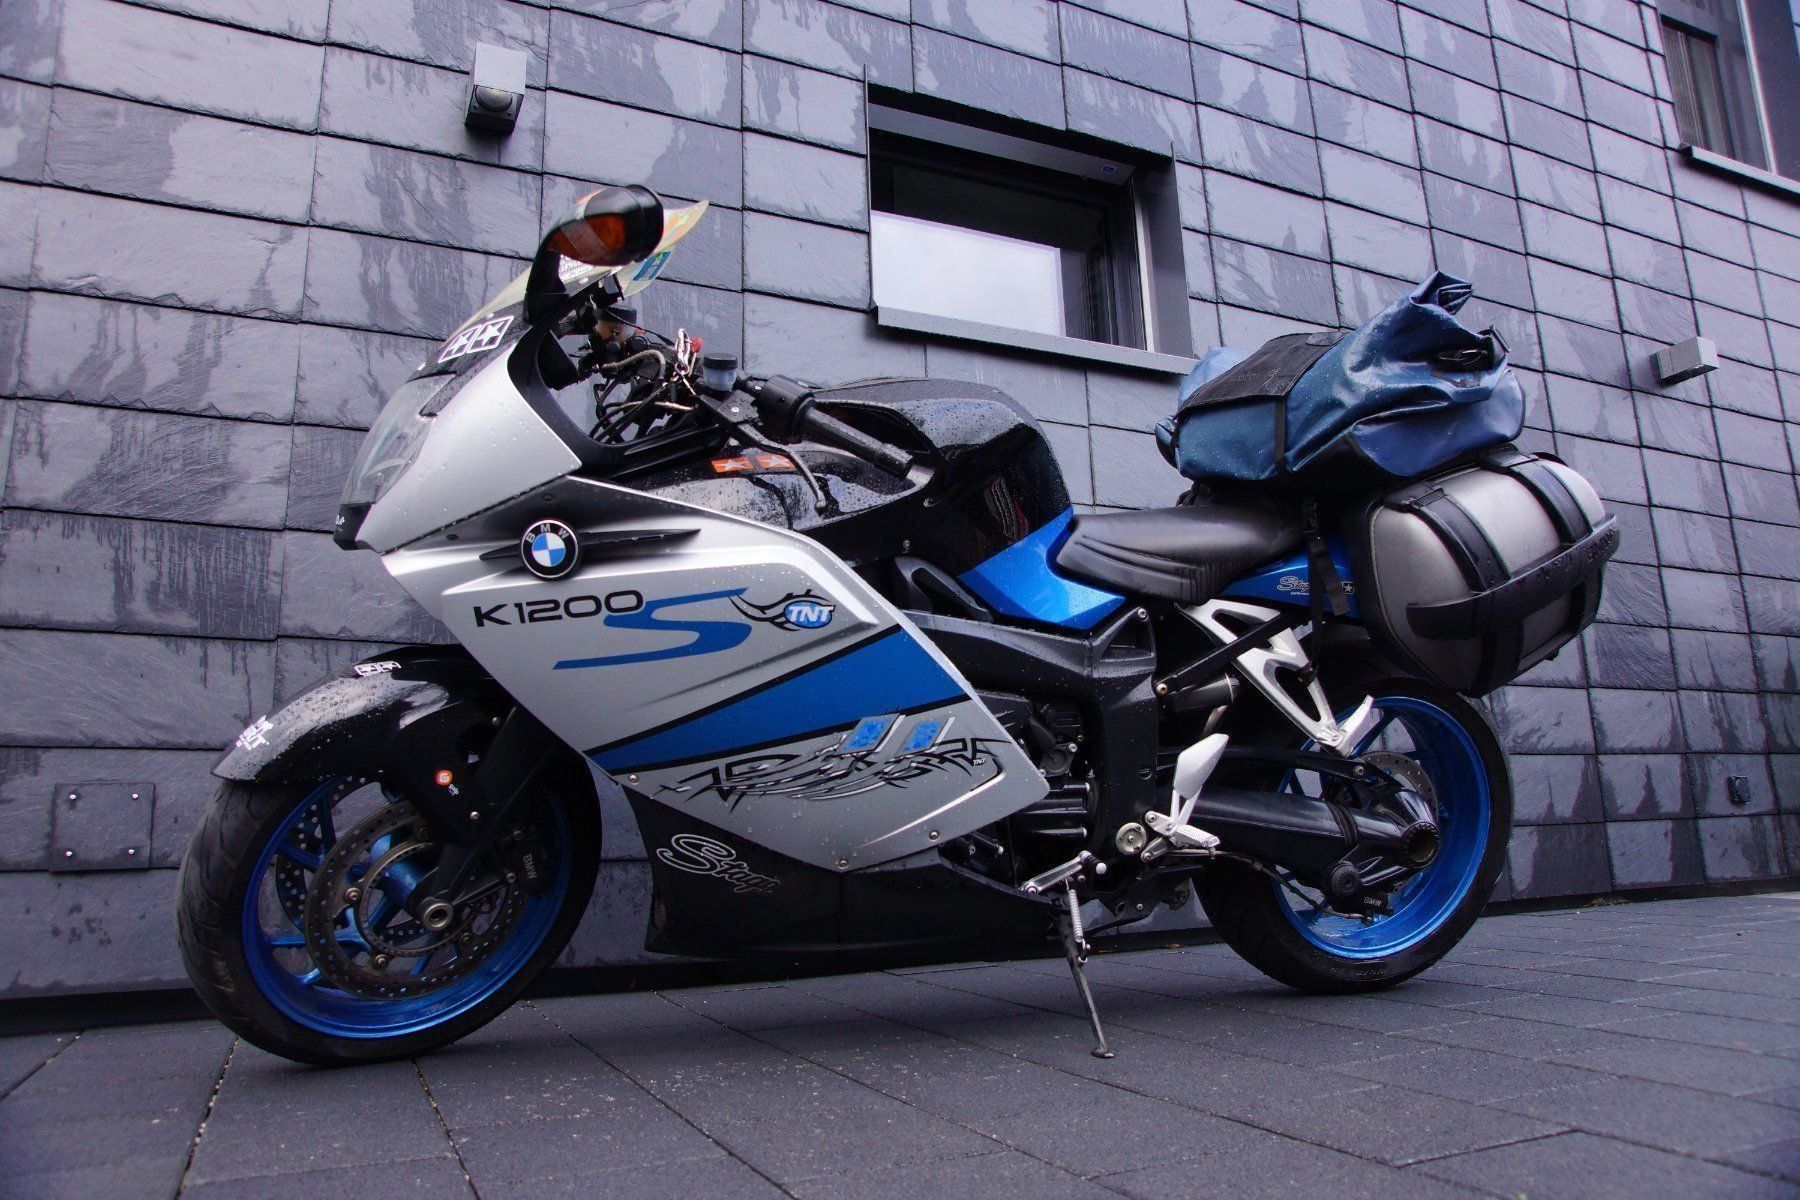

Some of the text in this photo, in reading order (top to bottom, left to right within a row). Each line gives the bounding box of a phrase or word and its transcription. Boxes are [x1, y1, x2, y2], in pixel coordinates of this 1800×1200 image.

[526, 522, 570, 542] BMW
[1277, 575, 1311, 592] Stag
[788, 604, 836, 623] TNT
[522, 853, 538, 879] BMW
[1364, 896, 1382, 907] BMW
